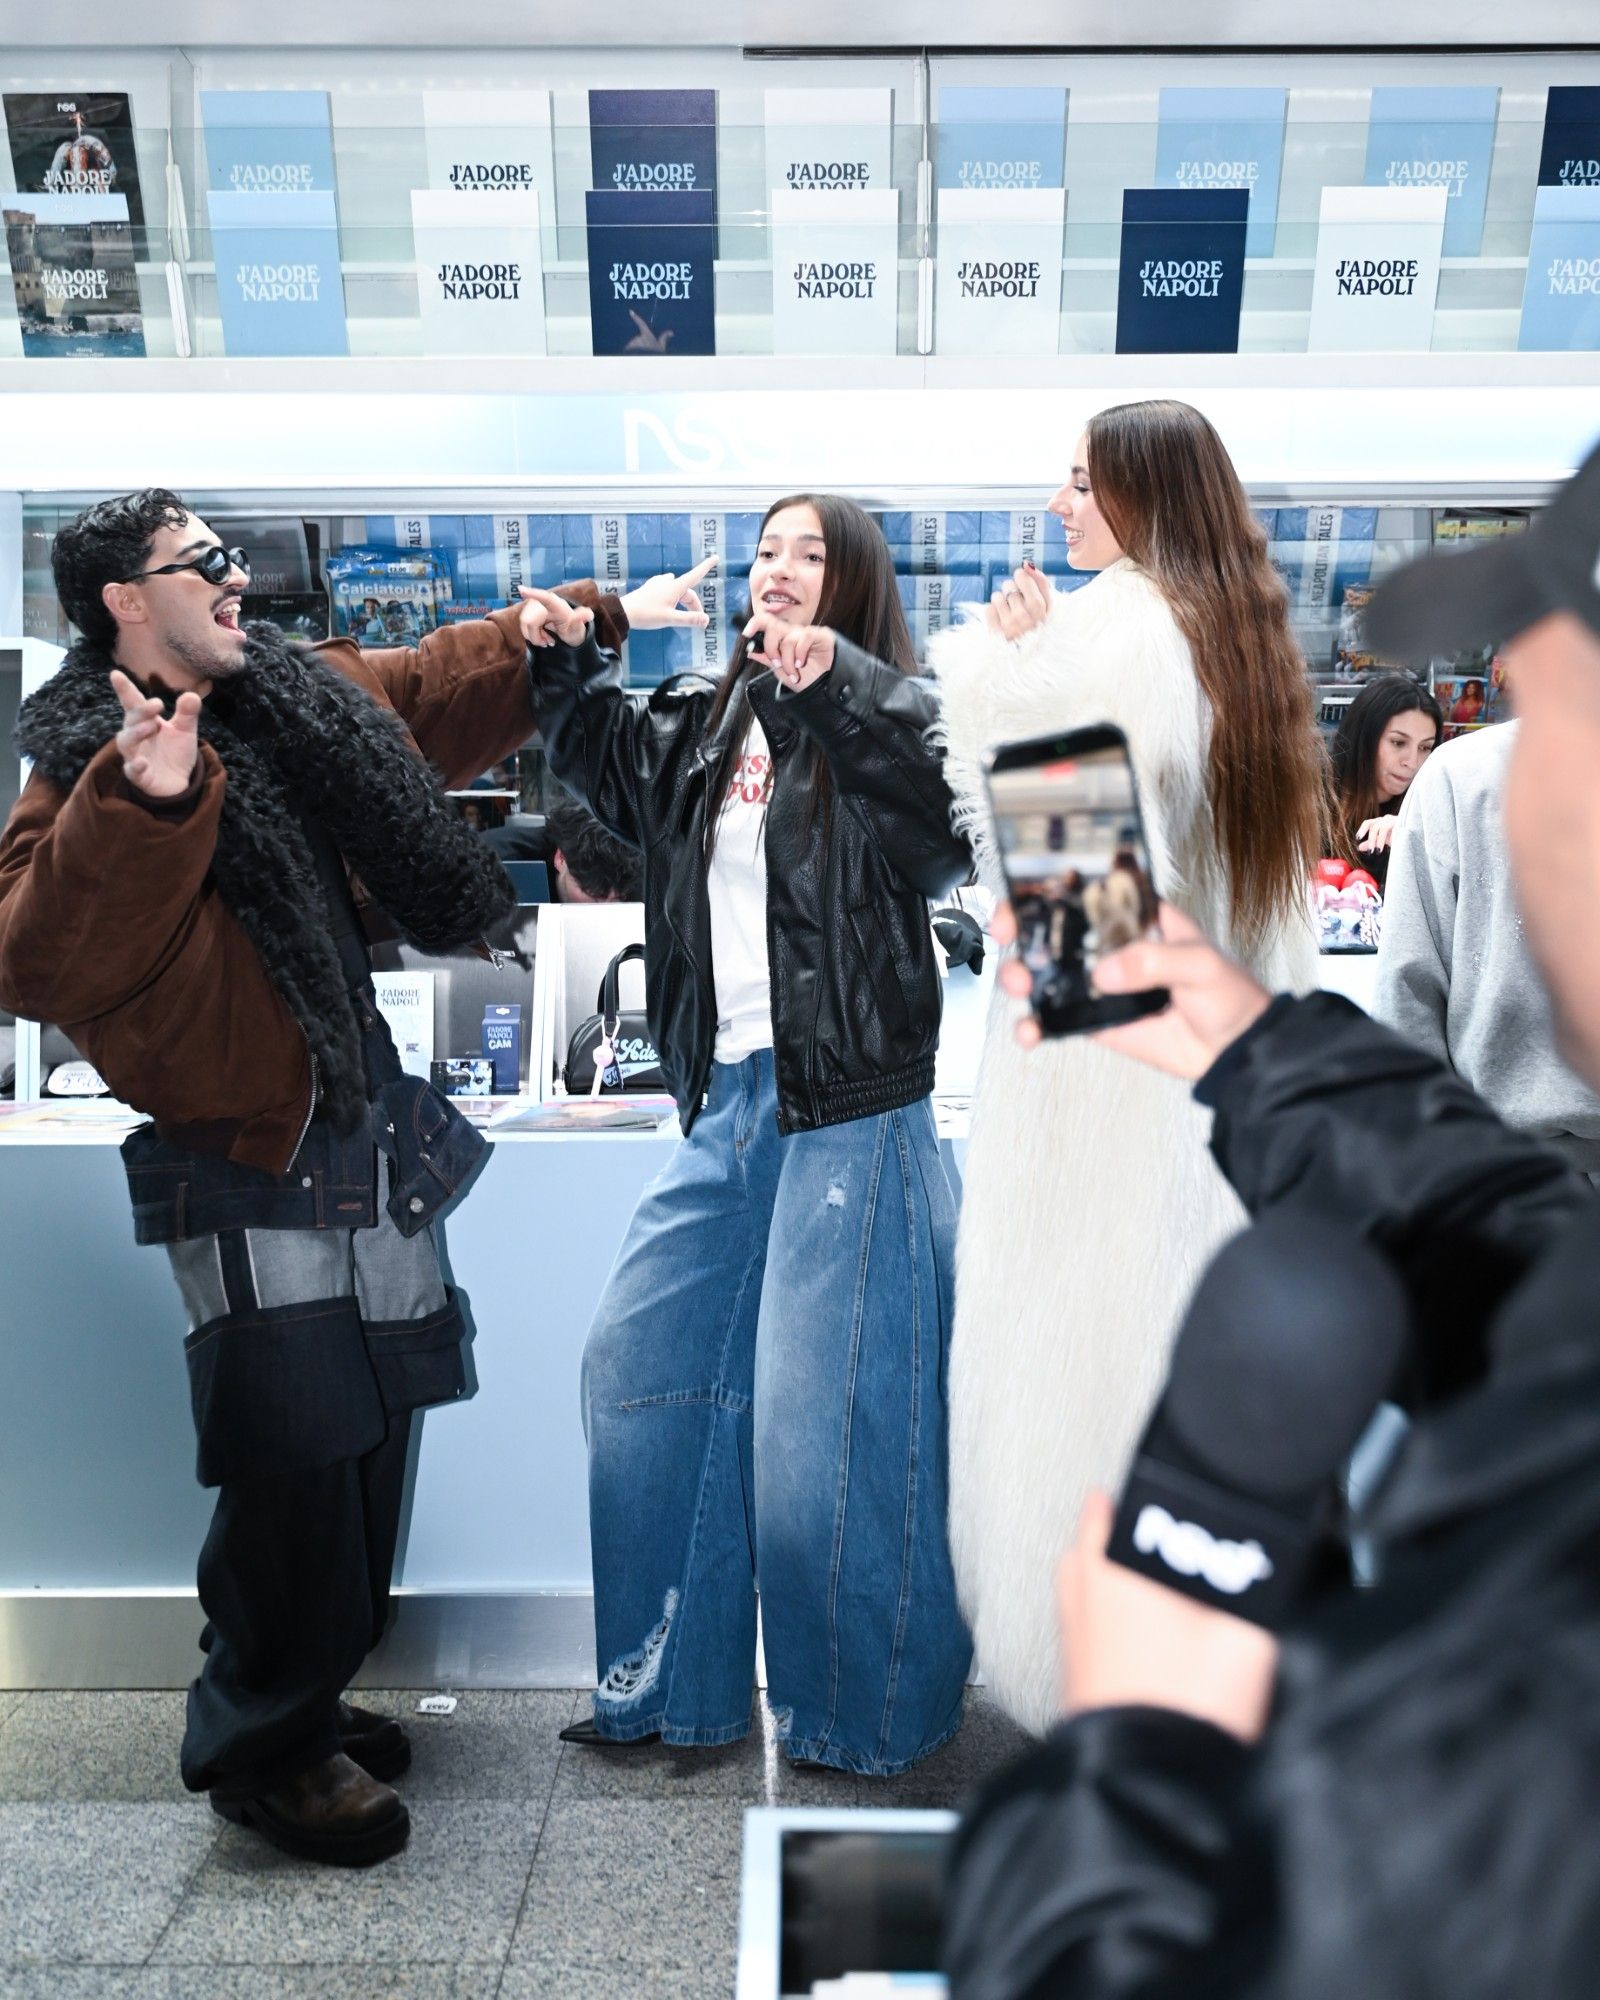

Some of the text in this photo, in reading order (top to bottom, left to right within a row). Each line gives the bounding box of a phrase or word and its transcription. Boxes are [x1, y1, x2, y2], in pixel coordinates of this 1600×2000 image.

[44, 170, 112, 186] J'ADORE
[229, 164, 314, 184] J'ADORE
[449, 164, 534, 182] J'ADORE
[612, 163, 697, 182] J'ADORE
[786, 162, 870, 181] J'ADORE
[958, 161, 1042, 180] J'ADORE
[1175, 161, 1259, 180] J'ADORE
[1385, 161, 1469, 179] J'ADORE
[40, 269, 109, 286] J'ADORE
[236, 264, 321, 283] J'ADORE
[438, 264, 522, 281] J'ADORE
[608, 262, 694, 281] J'ADORE
[793, 263, 877, 280] J'ADORE
[957, 262, 1041, 280] J'ADORE
[1139, 260, 1224, 278] J'ADORE
[1335, 260, 1418, 278] J'ADORE
[45, 284, 108, 299] NAPOLI
[241, 282, 319, 301] NAPOLI
[443, 283, 520, 299] NAPOLI
[613, 281, 690, 300] NAPOLI
[798, 281, 874, 299] NAPOLI
[961, 280, 1037, 298] NAPOLI
[1142, 278, 1219, 297] NAPOLI
[1337, 278, 1415, 296] NAPOLI
[507, 521, 520, 550] TALES
[605, 521, 619, 550] TALES
[704, 519, 716, 549] TALES
[924, 517, 937, 545] TALES
[1023, 516, 1036, 545] TALES
[1317, 514, 1333, 541] TALES
[1311, 545, 1330, 601] NEAPOLITAN
[338, 582, 415, 595] Calciatori
[928, 582, 942, 611] TALES
[703, 586, 716, 614] TALES
[382, 998, 420, 1006] NAPOLI
